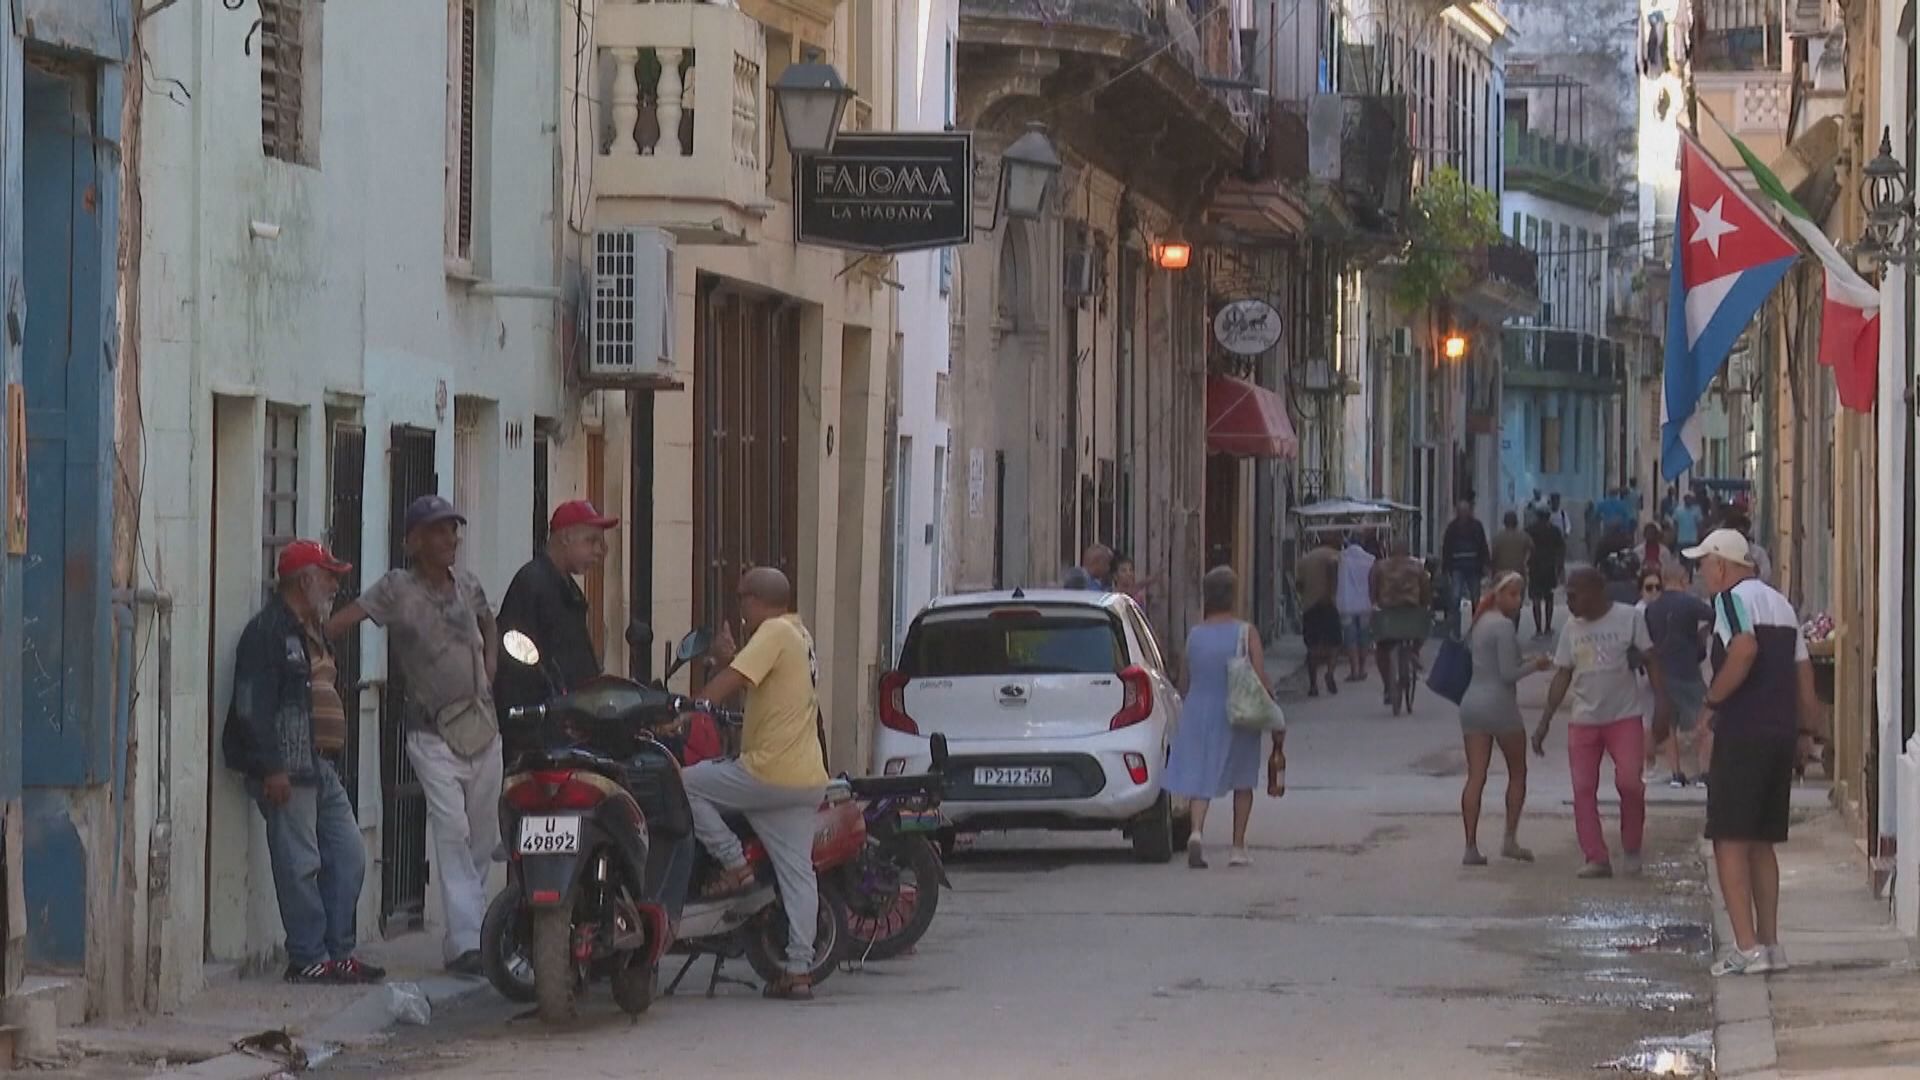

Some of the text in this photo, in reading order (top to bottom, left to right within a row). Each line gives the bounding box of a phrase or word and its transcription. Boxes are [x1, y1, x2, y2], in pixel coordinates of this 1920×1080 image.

[816, 165, 951, 197] FAJOMA
[831, 205, 851, 220] LA
[545, 817, 556, 833] U
[523, 835, 575, 851] 49892
